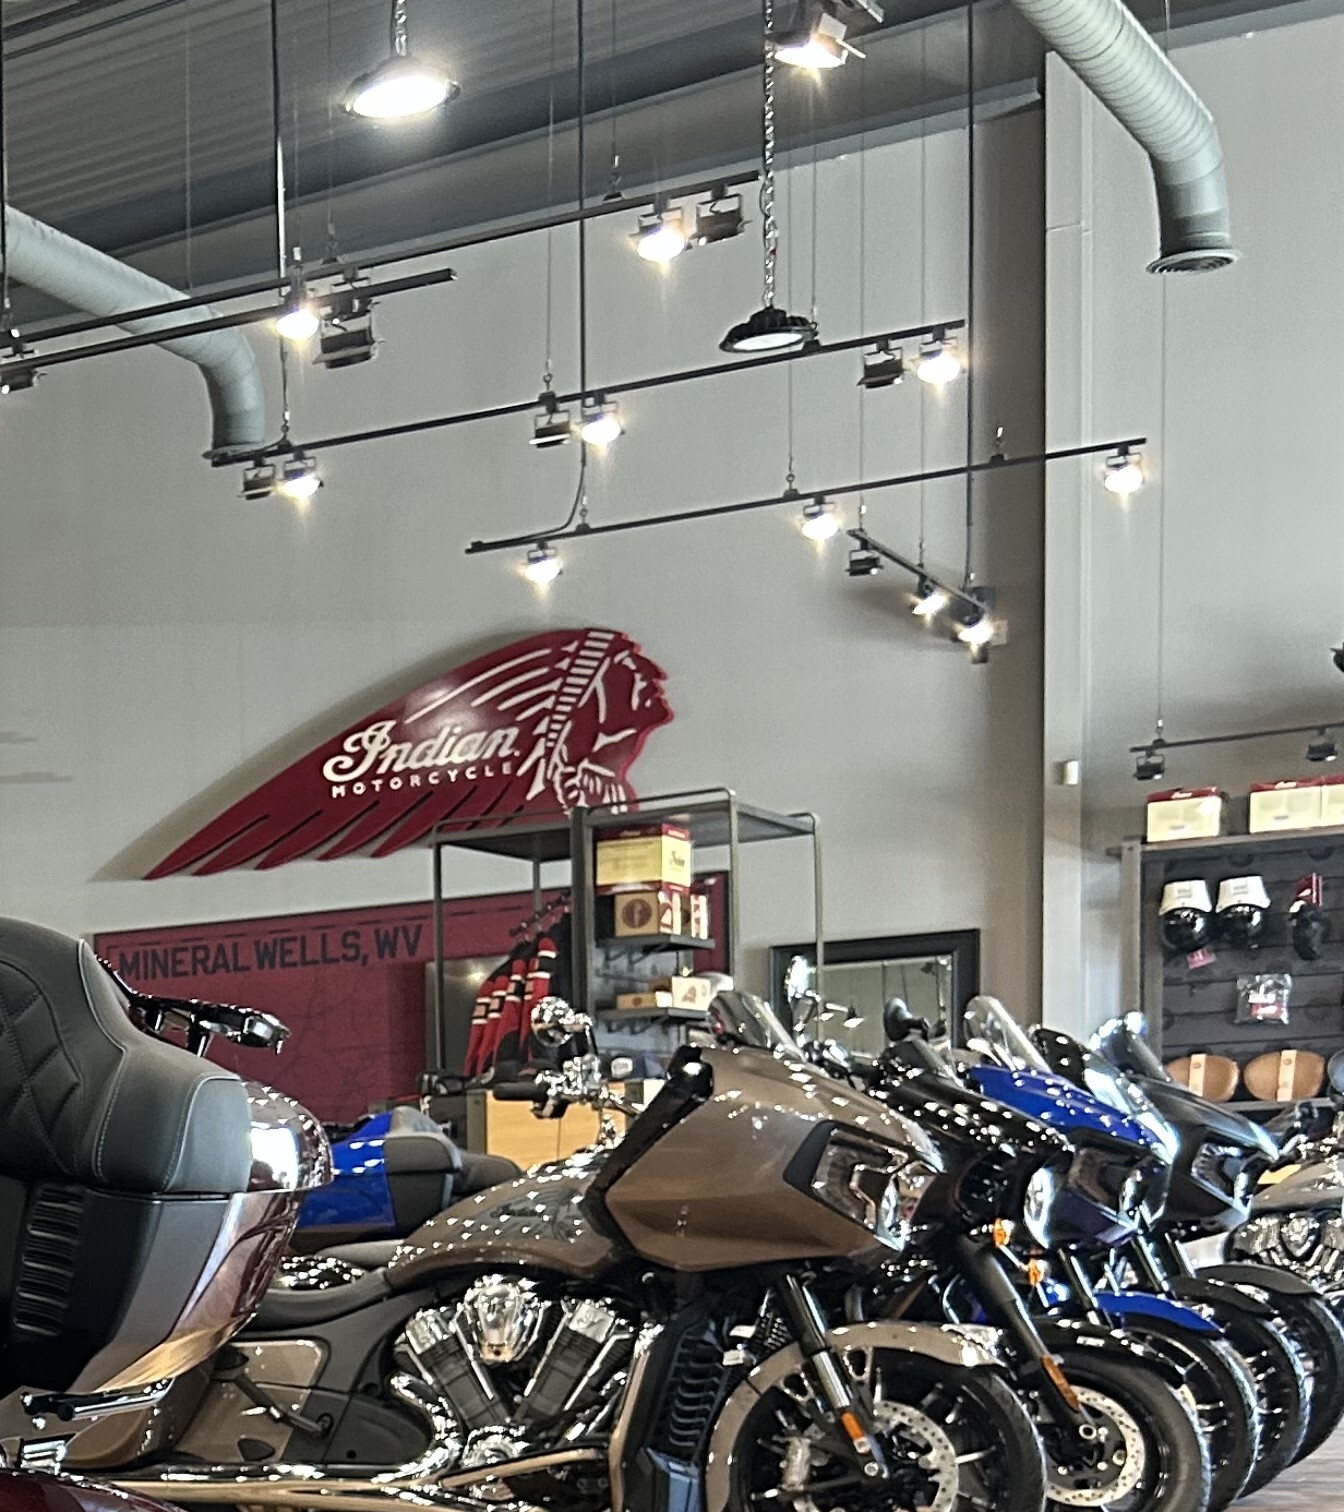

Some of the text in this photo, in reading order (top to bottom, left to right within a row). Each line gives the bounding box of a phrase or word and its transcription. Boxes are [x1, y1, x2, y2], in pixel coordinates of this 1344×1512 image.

[322, 719, 520, 783] Indian
[331, 761, 512, 799] MOTORCYCLE
[117, 924, 424, 981] MINERAL WELLS, WV
